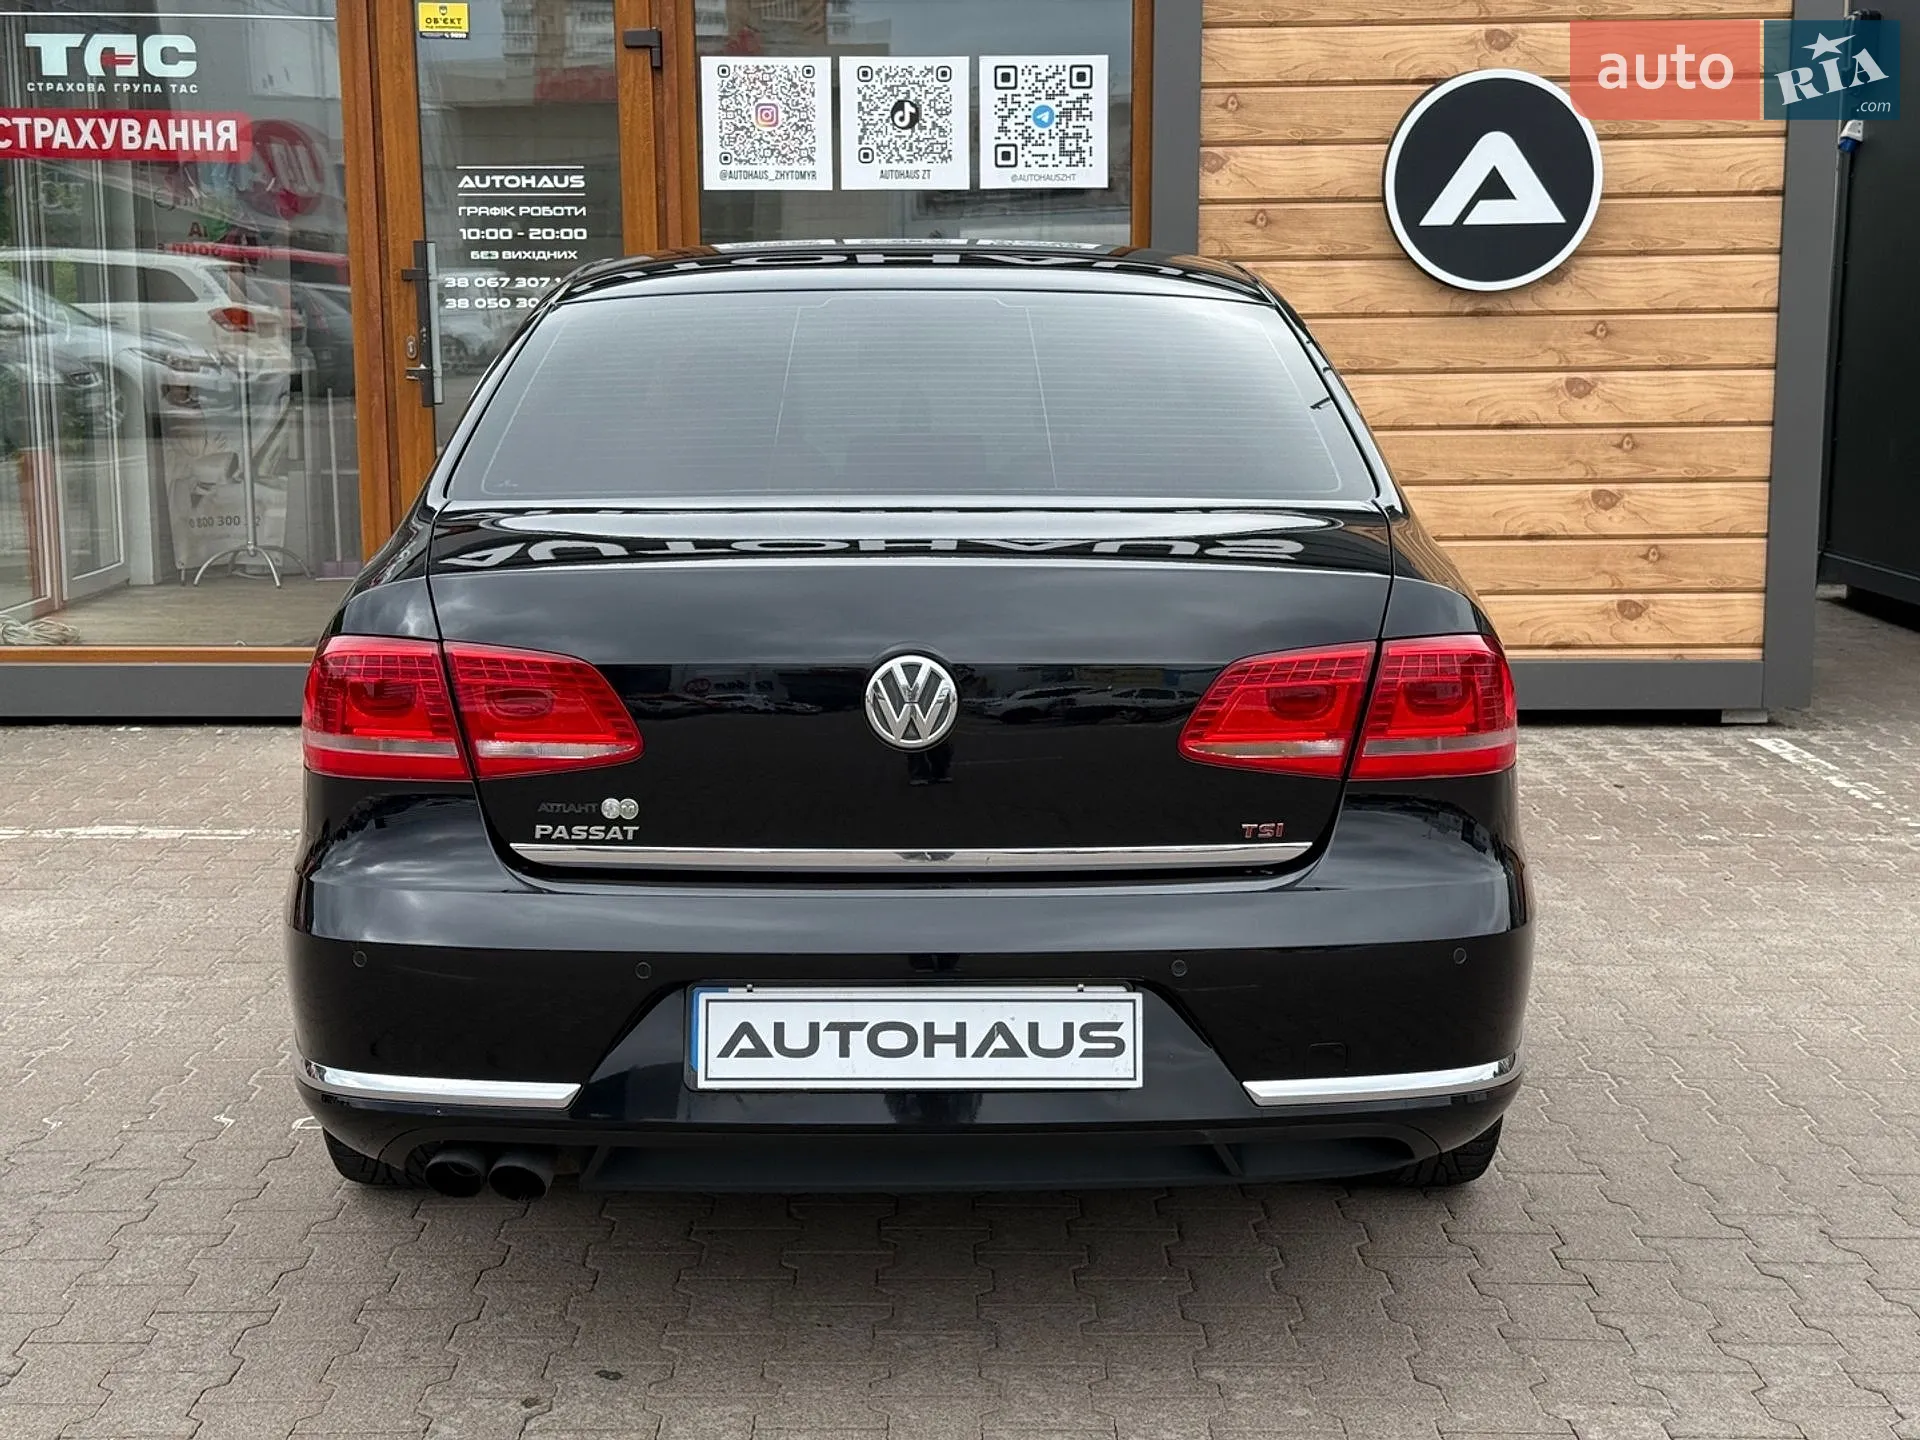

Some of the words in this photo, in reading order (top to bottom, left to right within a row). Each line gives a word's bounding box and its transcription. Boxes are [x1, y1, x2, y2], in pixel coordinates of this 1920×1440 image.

[24, 33, 198, 78] ТАС
[26, 82, 106, 93] СТРАХОВА
[113, 82, 163, 93] ГРУПА
[170, 83, 199, 94] ТАС
[0, 117, 238, 152] СТРАХУВАННЯ
[719, 169, 818, 181] @AUTOHAUS_ZHYTOMYR
[879, 169, 920, 180] AUTOHAUS
[921, 169, 932, 180] ZT
[457, 175, 586, 188] AUTOHAUS
[458, 206, 516, 217] ГРАФІК
[518, 206, 587, 217] РОБОТИ
[459, 228, 513, 240] 10:00
[528, 228, 588, 240] 20:00
[470, 250, 499, 260] БЕЗ
[502, 250, 578, 261] ВИХІДНИХ
[445, 277, 469, 288] 38
[474, 277, 511, 288] 067
[515, 277, 551, 288] 307
[445, 298, 470, 309] 38
[474, 298, 511, 309] 050
[516, 298, 540, 309] 30
[217, 515, 241, 527] 300
[535, 825, 640, 840] PASSAT
[1241, 823, 1284, 838] TSI
[716, 1021, 1127, 1058] AUTOHAUS
